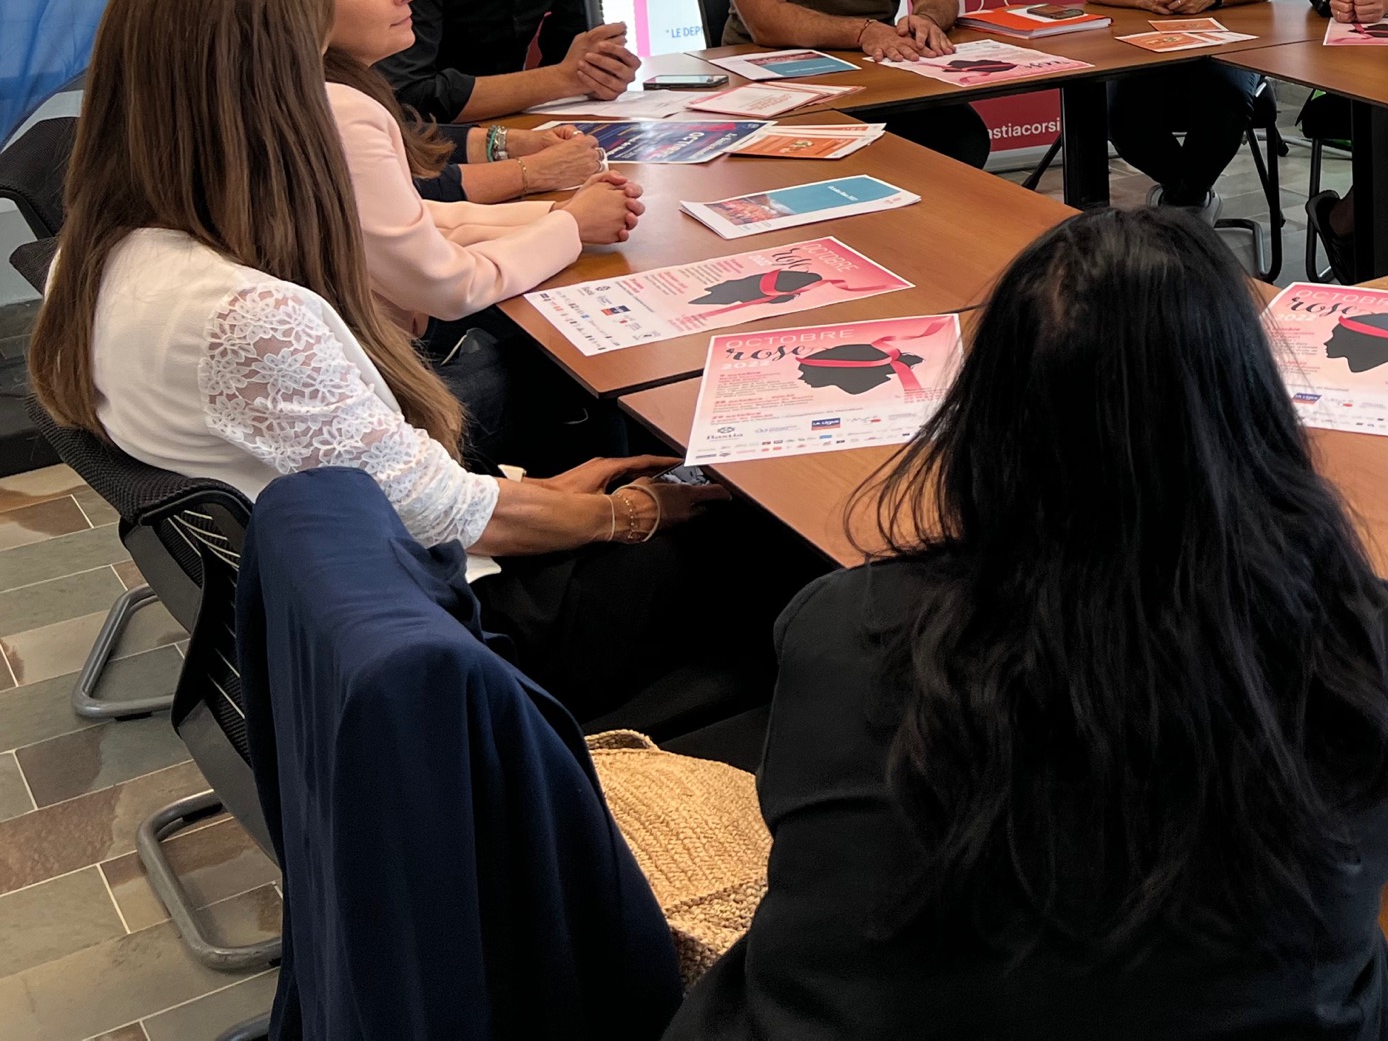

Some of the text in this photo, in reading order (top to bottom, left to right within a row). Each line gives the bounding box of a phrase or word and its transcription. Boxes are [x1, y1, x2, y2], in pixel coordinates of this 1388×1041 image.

[671, 28, 681, 38] LE
[1289, 296, 1358, 317] rose
[725, 328, 855, 348] OCTOBRE
[726, 341, 814, 362] rose
[720, 359, 771, 371] 2022
